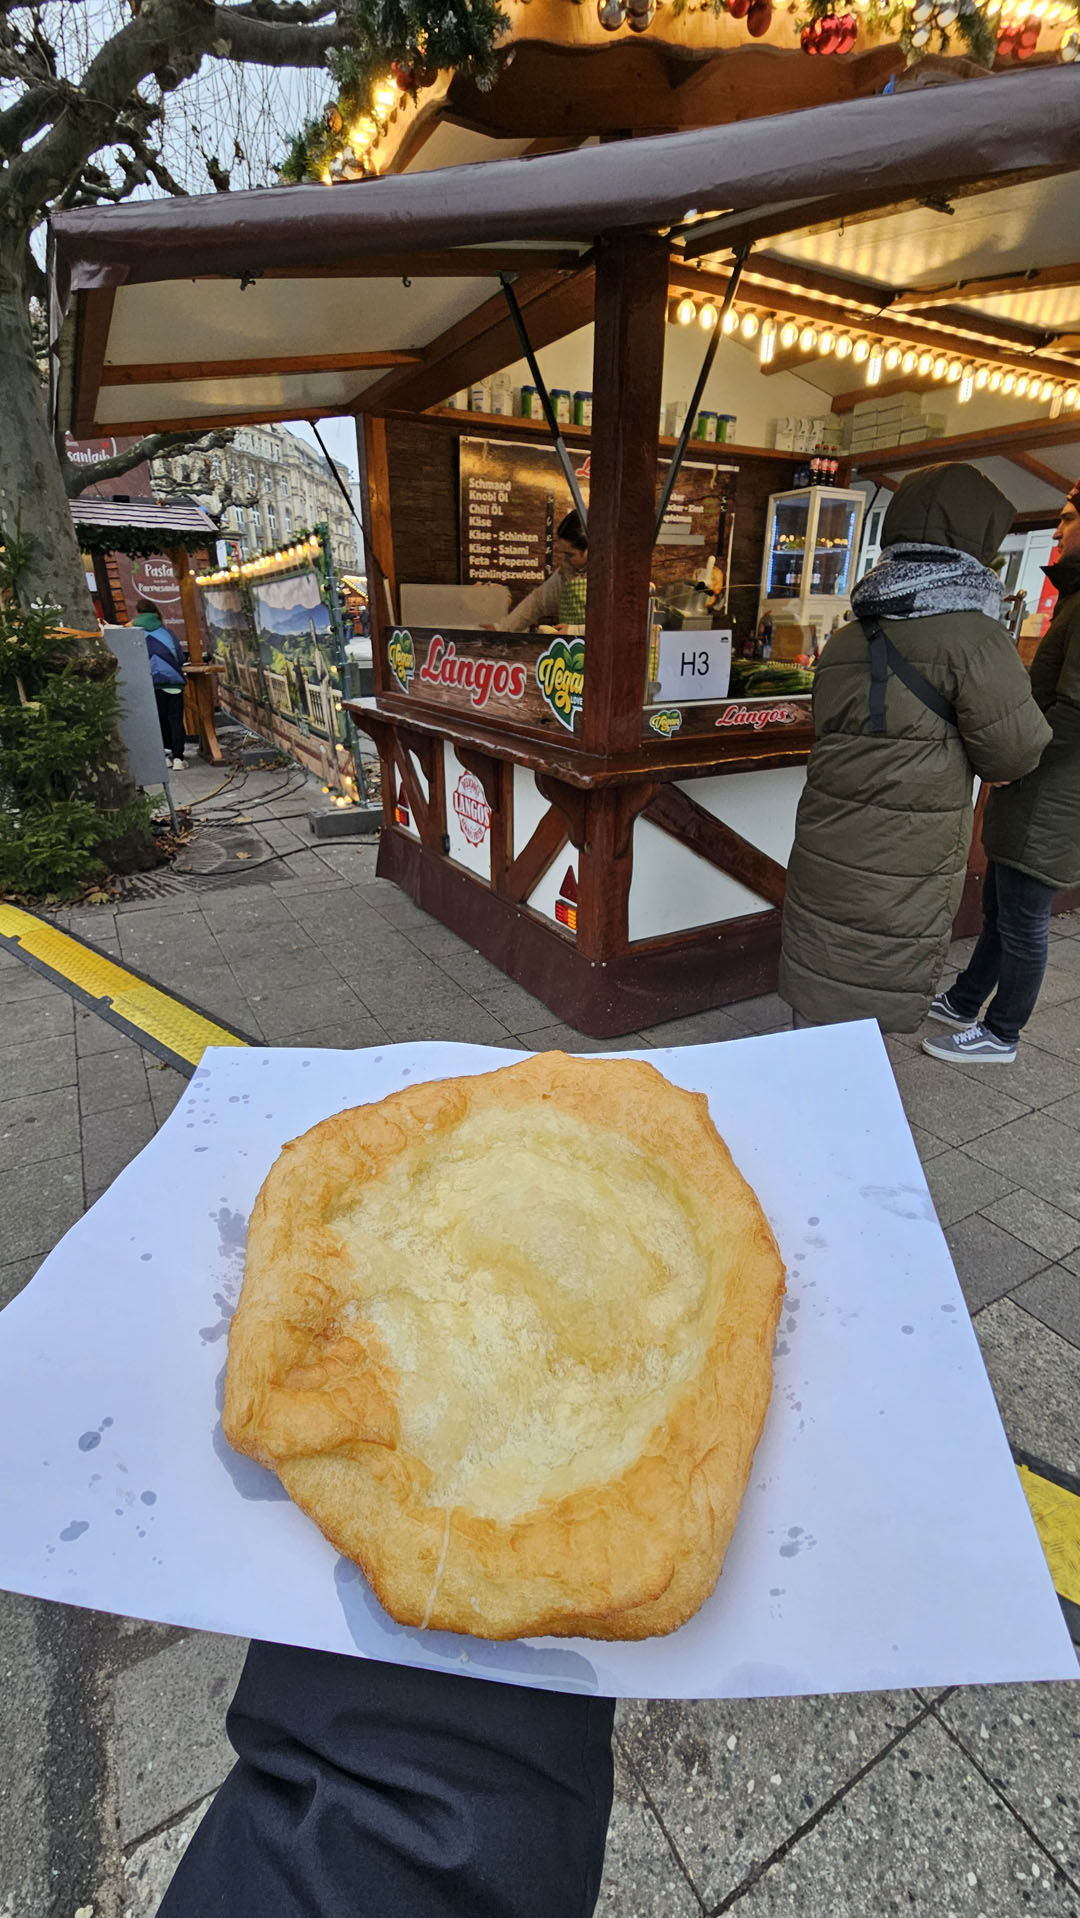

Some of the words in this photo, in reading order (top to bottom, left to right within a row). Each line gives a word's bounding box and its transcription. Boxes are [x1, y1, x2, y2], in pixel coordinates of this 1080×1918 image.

[468, 478, 511, 491] Schmand
[468, 490, 497, 502] Knobi
[468, 503, 490, 515] Chili
[468, 516, 492, 527] Käse
[663, 513, 692, 523] pfelmus
[468, 530, 492, 541] Käse
[498, 531, 539, 542] Schinken
[468, 543, 492, 554] Käse
[498, 545, 530, 555] Salami
[468, 556, 490, 566] Feta
[498, 556, 539, 567] Peperoni
[145, 563, 174, 577] Pasta
[468, 569, 545, 580] Frühlingszwiebel
[138, 583, 180, 592] Parmesanla
[389, 643, 414, 682] Vegan
[681, 651, 710, 677] H3
[420, 634, 527, 709] Lángos
[715, 704, 788, 730] Lángos
[652, 715, 680, 732] Vegan
[454, 791, 490, 829] LANGOS
